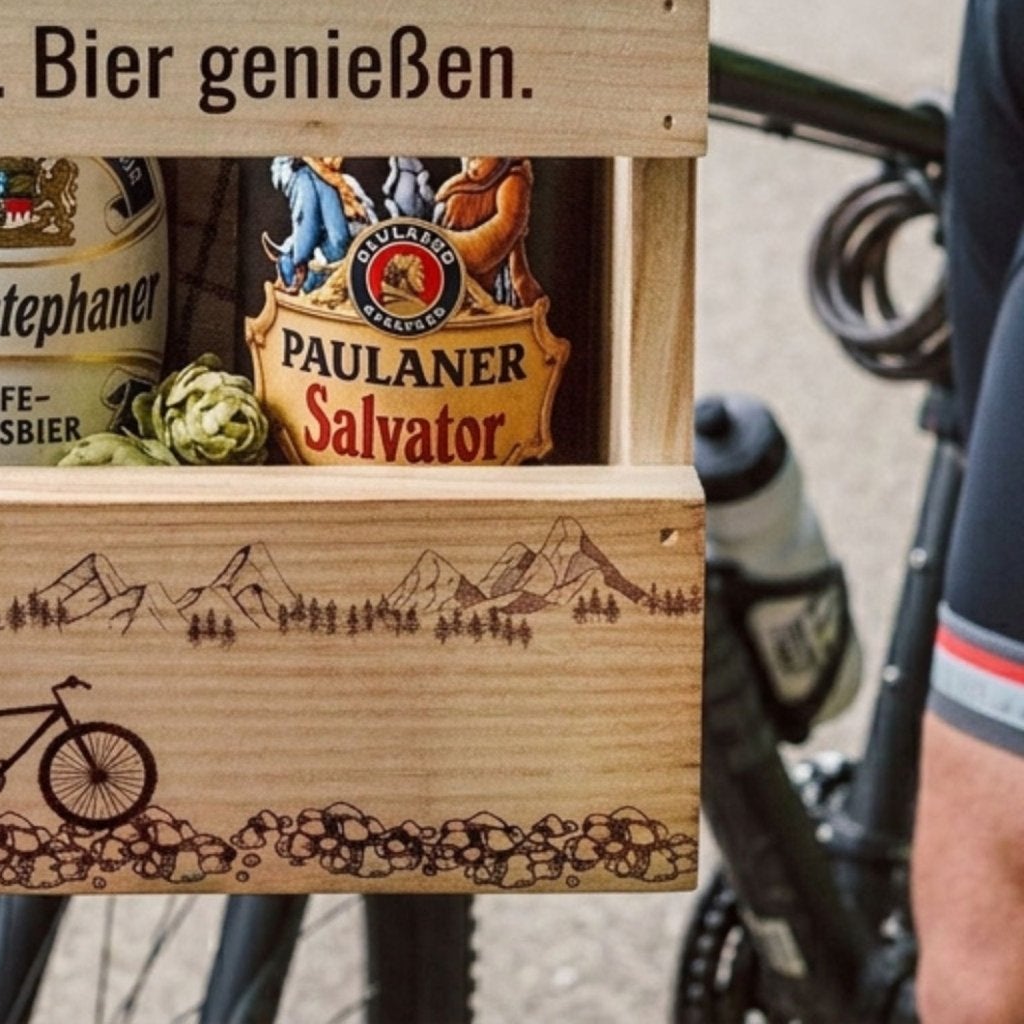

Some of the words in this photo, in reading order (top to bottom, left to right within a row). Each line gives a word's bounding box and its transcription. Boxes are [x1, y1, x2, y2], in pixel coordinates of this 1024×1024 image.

[34, 25, 174, 99] Bier
[198, 25, 533, 115] genießen.
[281, 327, 528, 389] PAULANER
[304, 382, 506, 465] Salvator
